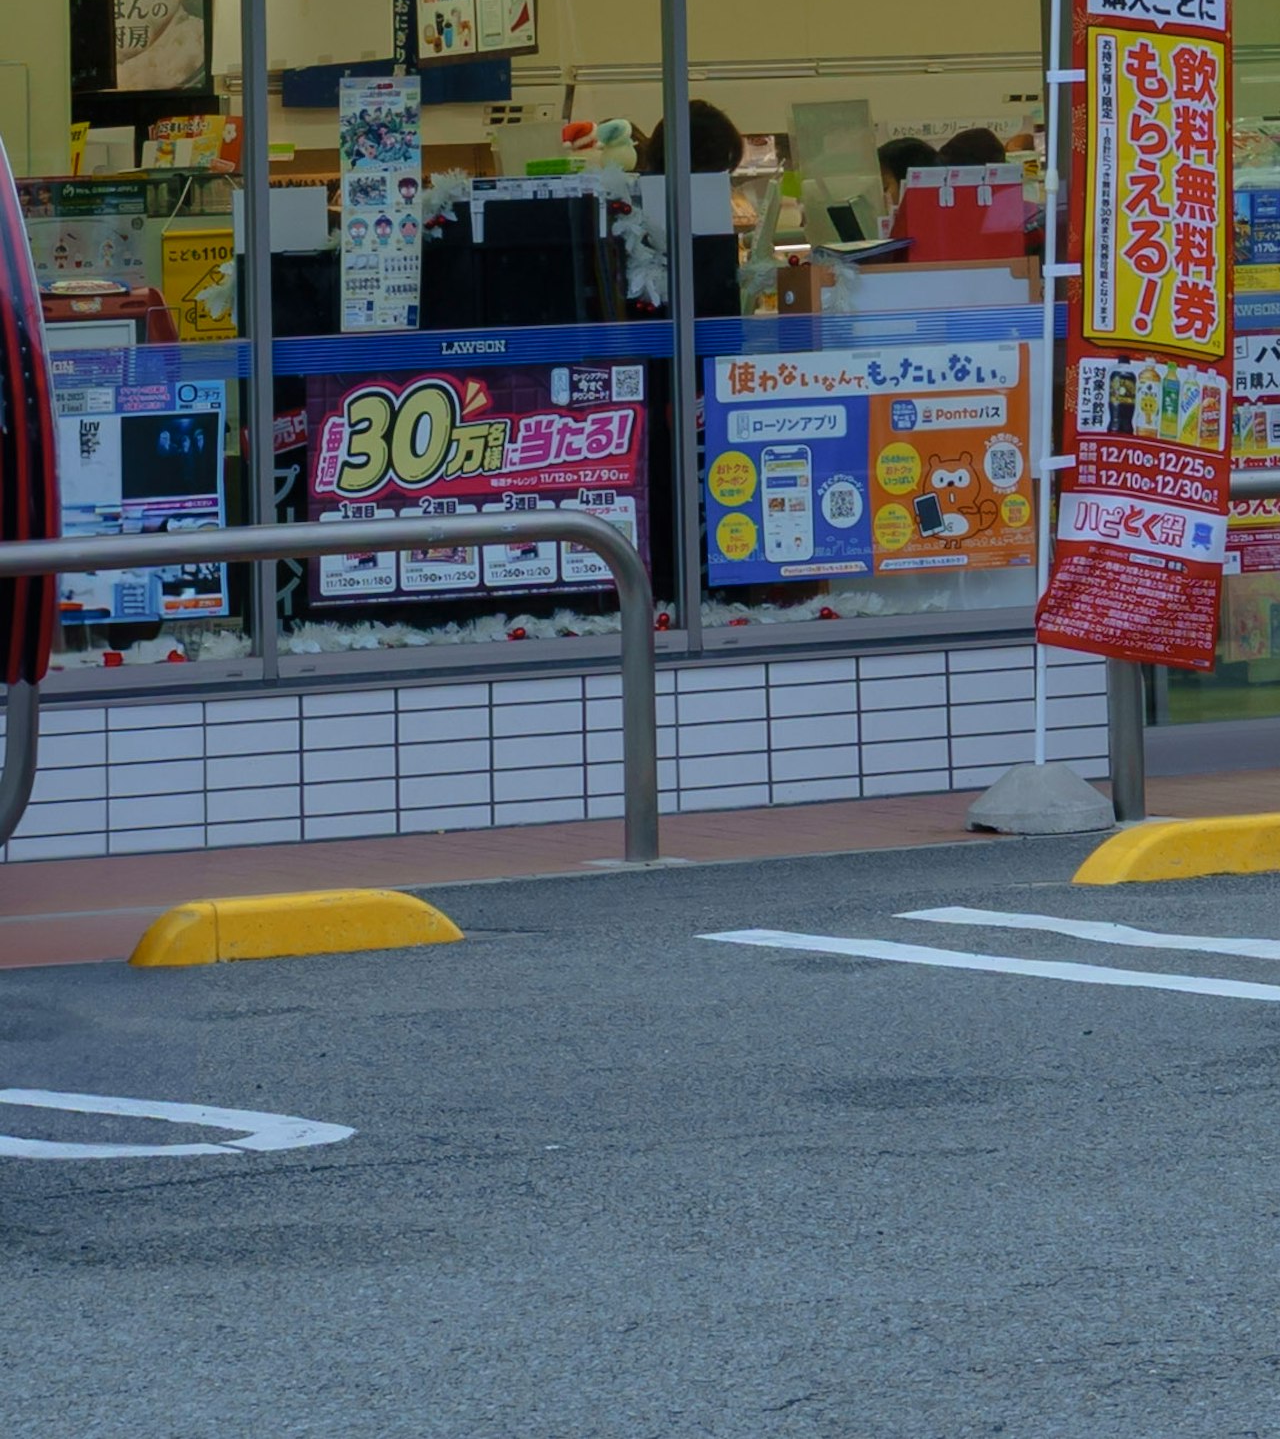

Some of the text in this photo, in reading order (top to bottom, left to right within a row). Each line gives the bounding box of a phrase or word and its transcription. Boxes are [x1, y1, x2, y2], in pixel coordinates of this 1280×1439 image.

[1100, 38, 1113, 121] お持ち帰り限定
[1123, 40, 1170, 333] もらえる!
[1172, 45, 1218, 340] 飲料無料券
[168, 245, 234, 262] こども110
[440, 339, 506, 356] LAWSON
[752, 413, 838, 433] ローソンアプリ
[935, 405, 1001, 422] Pontaパス
[1080, 365, 1093, 427] いずれか一本
[1091, 366, 1107, 428] 対象の飲料
[421, 499, 457, 515] 2週目
[504, 494, 538, 511] 3週目
[578, 490, 615, 506] 4週目
[1074, 500, 1186, 548] ハピとく祭
